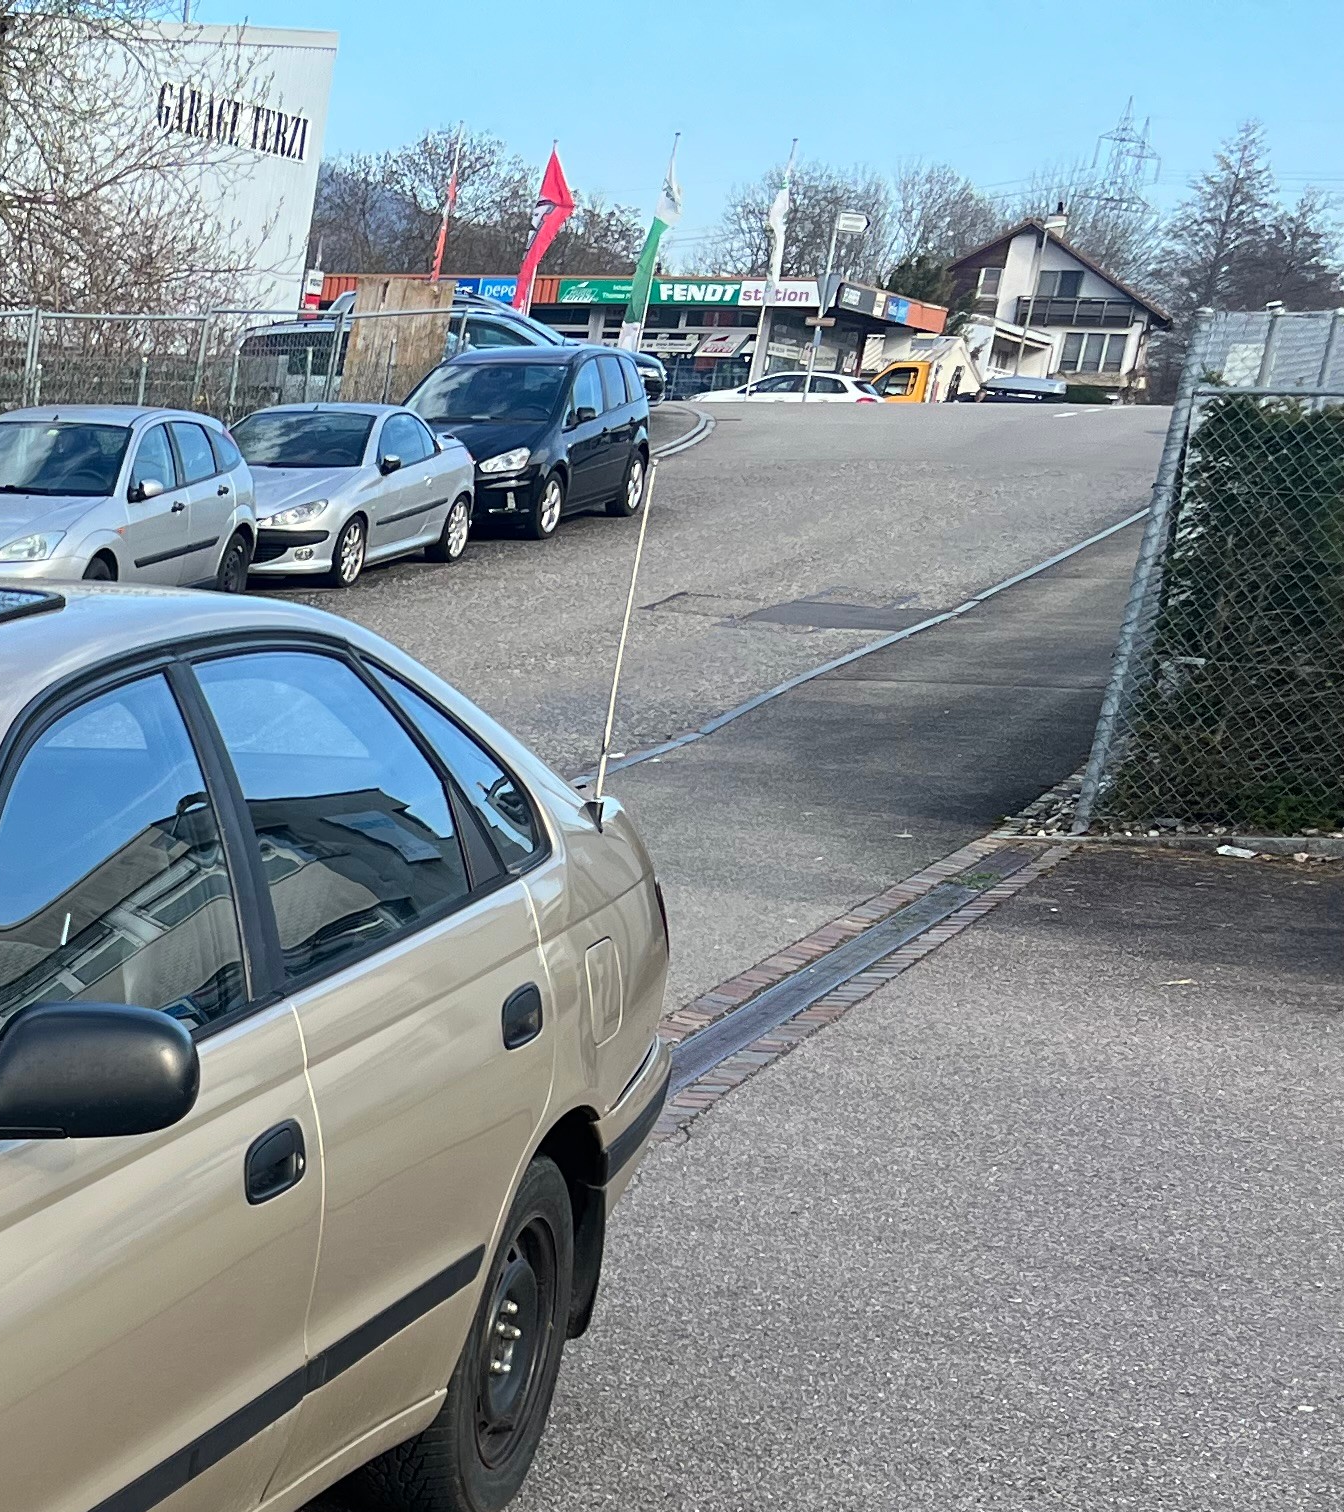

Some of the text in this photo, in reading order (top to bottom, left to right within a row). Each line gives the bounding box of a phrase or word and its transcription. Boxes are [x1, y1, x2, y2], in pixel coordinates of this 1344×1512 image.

[157, 81, 309, 160] GARAGE TERZI
[659, 283, 810, 303] FENDT sttion
